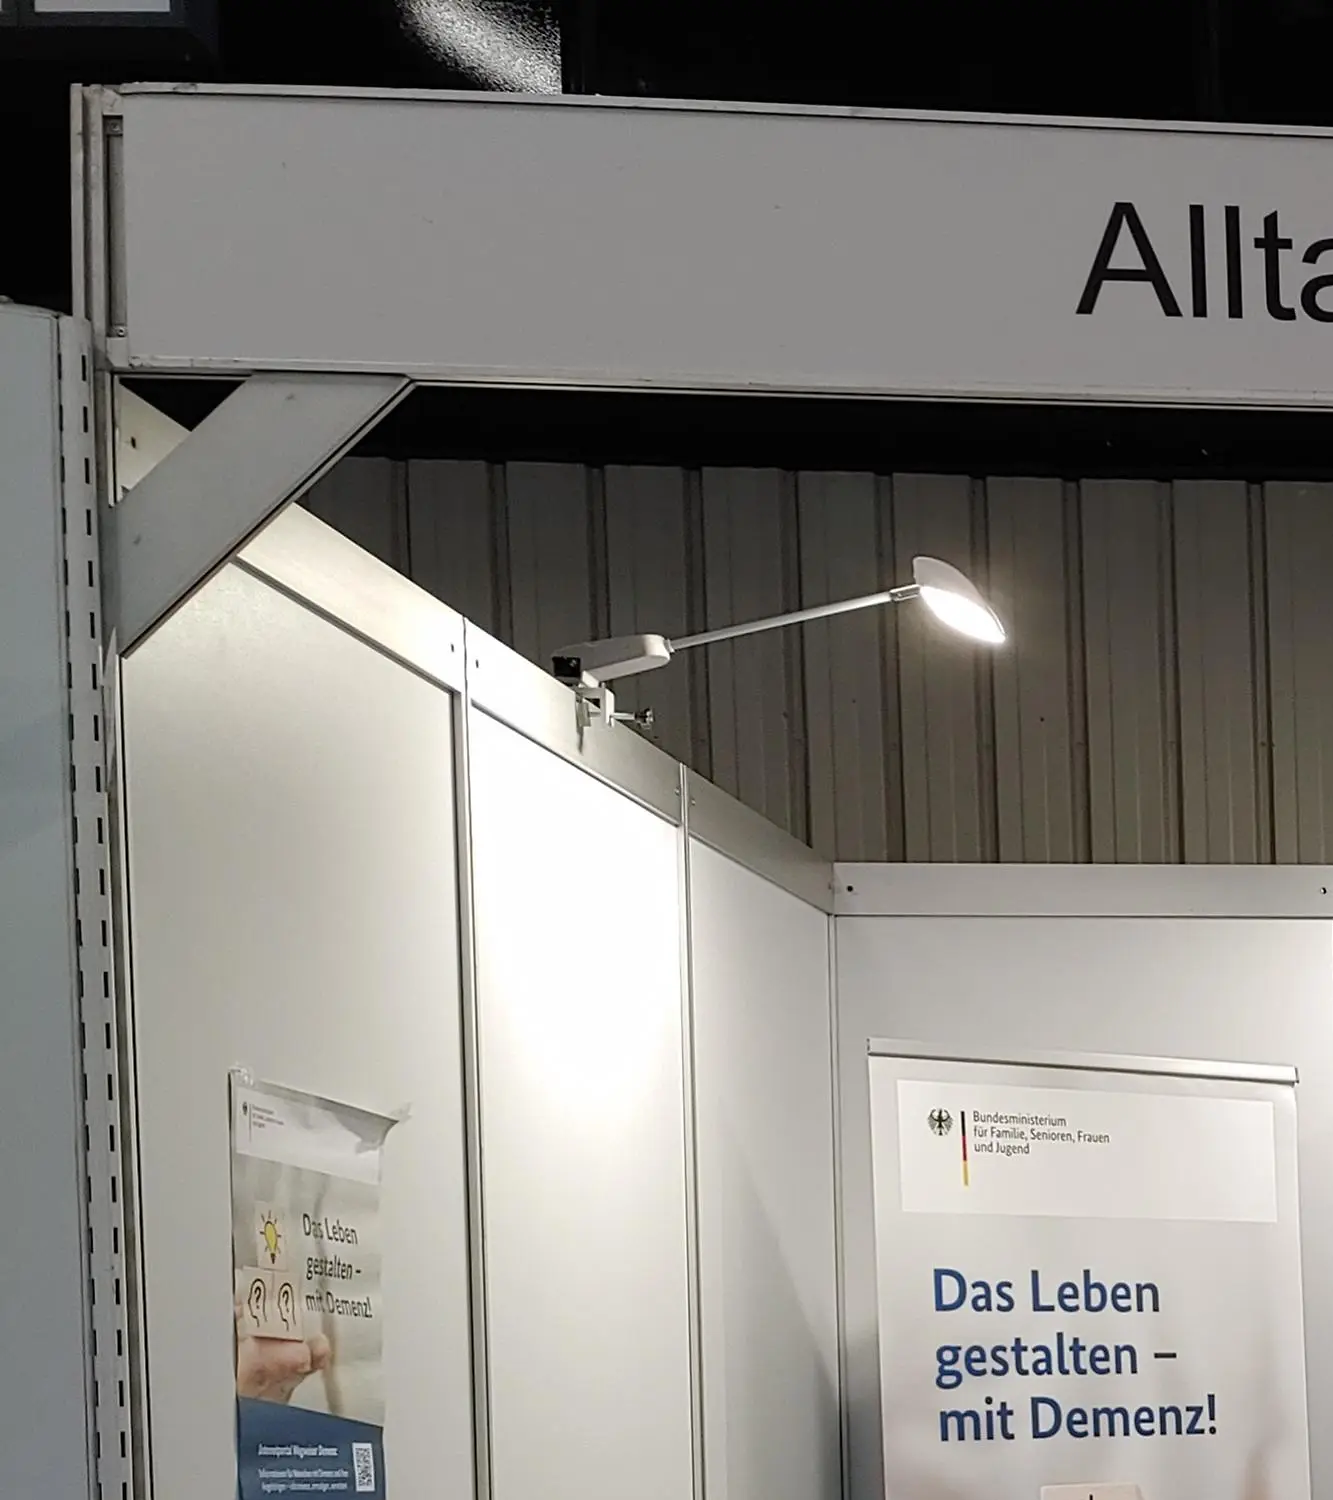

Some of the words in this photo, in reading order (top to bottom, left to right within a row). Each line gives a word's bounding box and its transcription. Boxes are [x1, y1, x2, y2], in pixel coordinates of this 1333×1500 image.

[973, 1110, 1067, 1127] Bundesministerium
[973, 1126, 988, 1139] für
[990, 1127, 1028, 1142] Familie,
[1030, 1129, 1076, 1144] Senioren,
[1077, 1131, 1110, 1144] Frauen
[974, 1142, 993, 1154] und
[996, 1143, 1030, 1156] Jugend
[302, 1212, 323, 1242] Das
[324, 1214, 358, 1246] Leben
[306, 1254, 353, 1282] gestalten
[305, 1289, 324, 1314] mit
[326, 1291, 373, 1319] Demenz!
[933, 1268, 1014, 1313] Das
[1031, 1269, 1159, 1312] Leben
[936, 1332, 1138, 1390] gestalten
[939, 1396, 1015, 1442] mit
[1031, 1394, 1217, 1439] Demenz!
